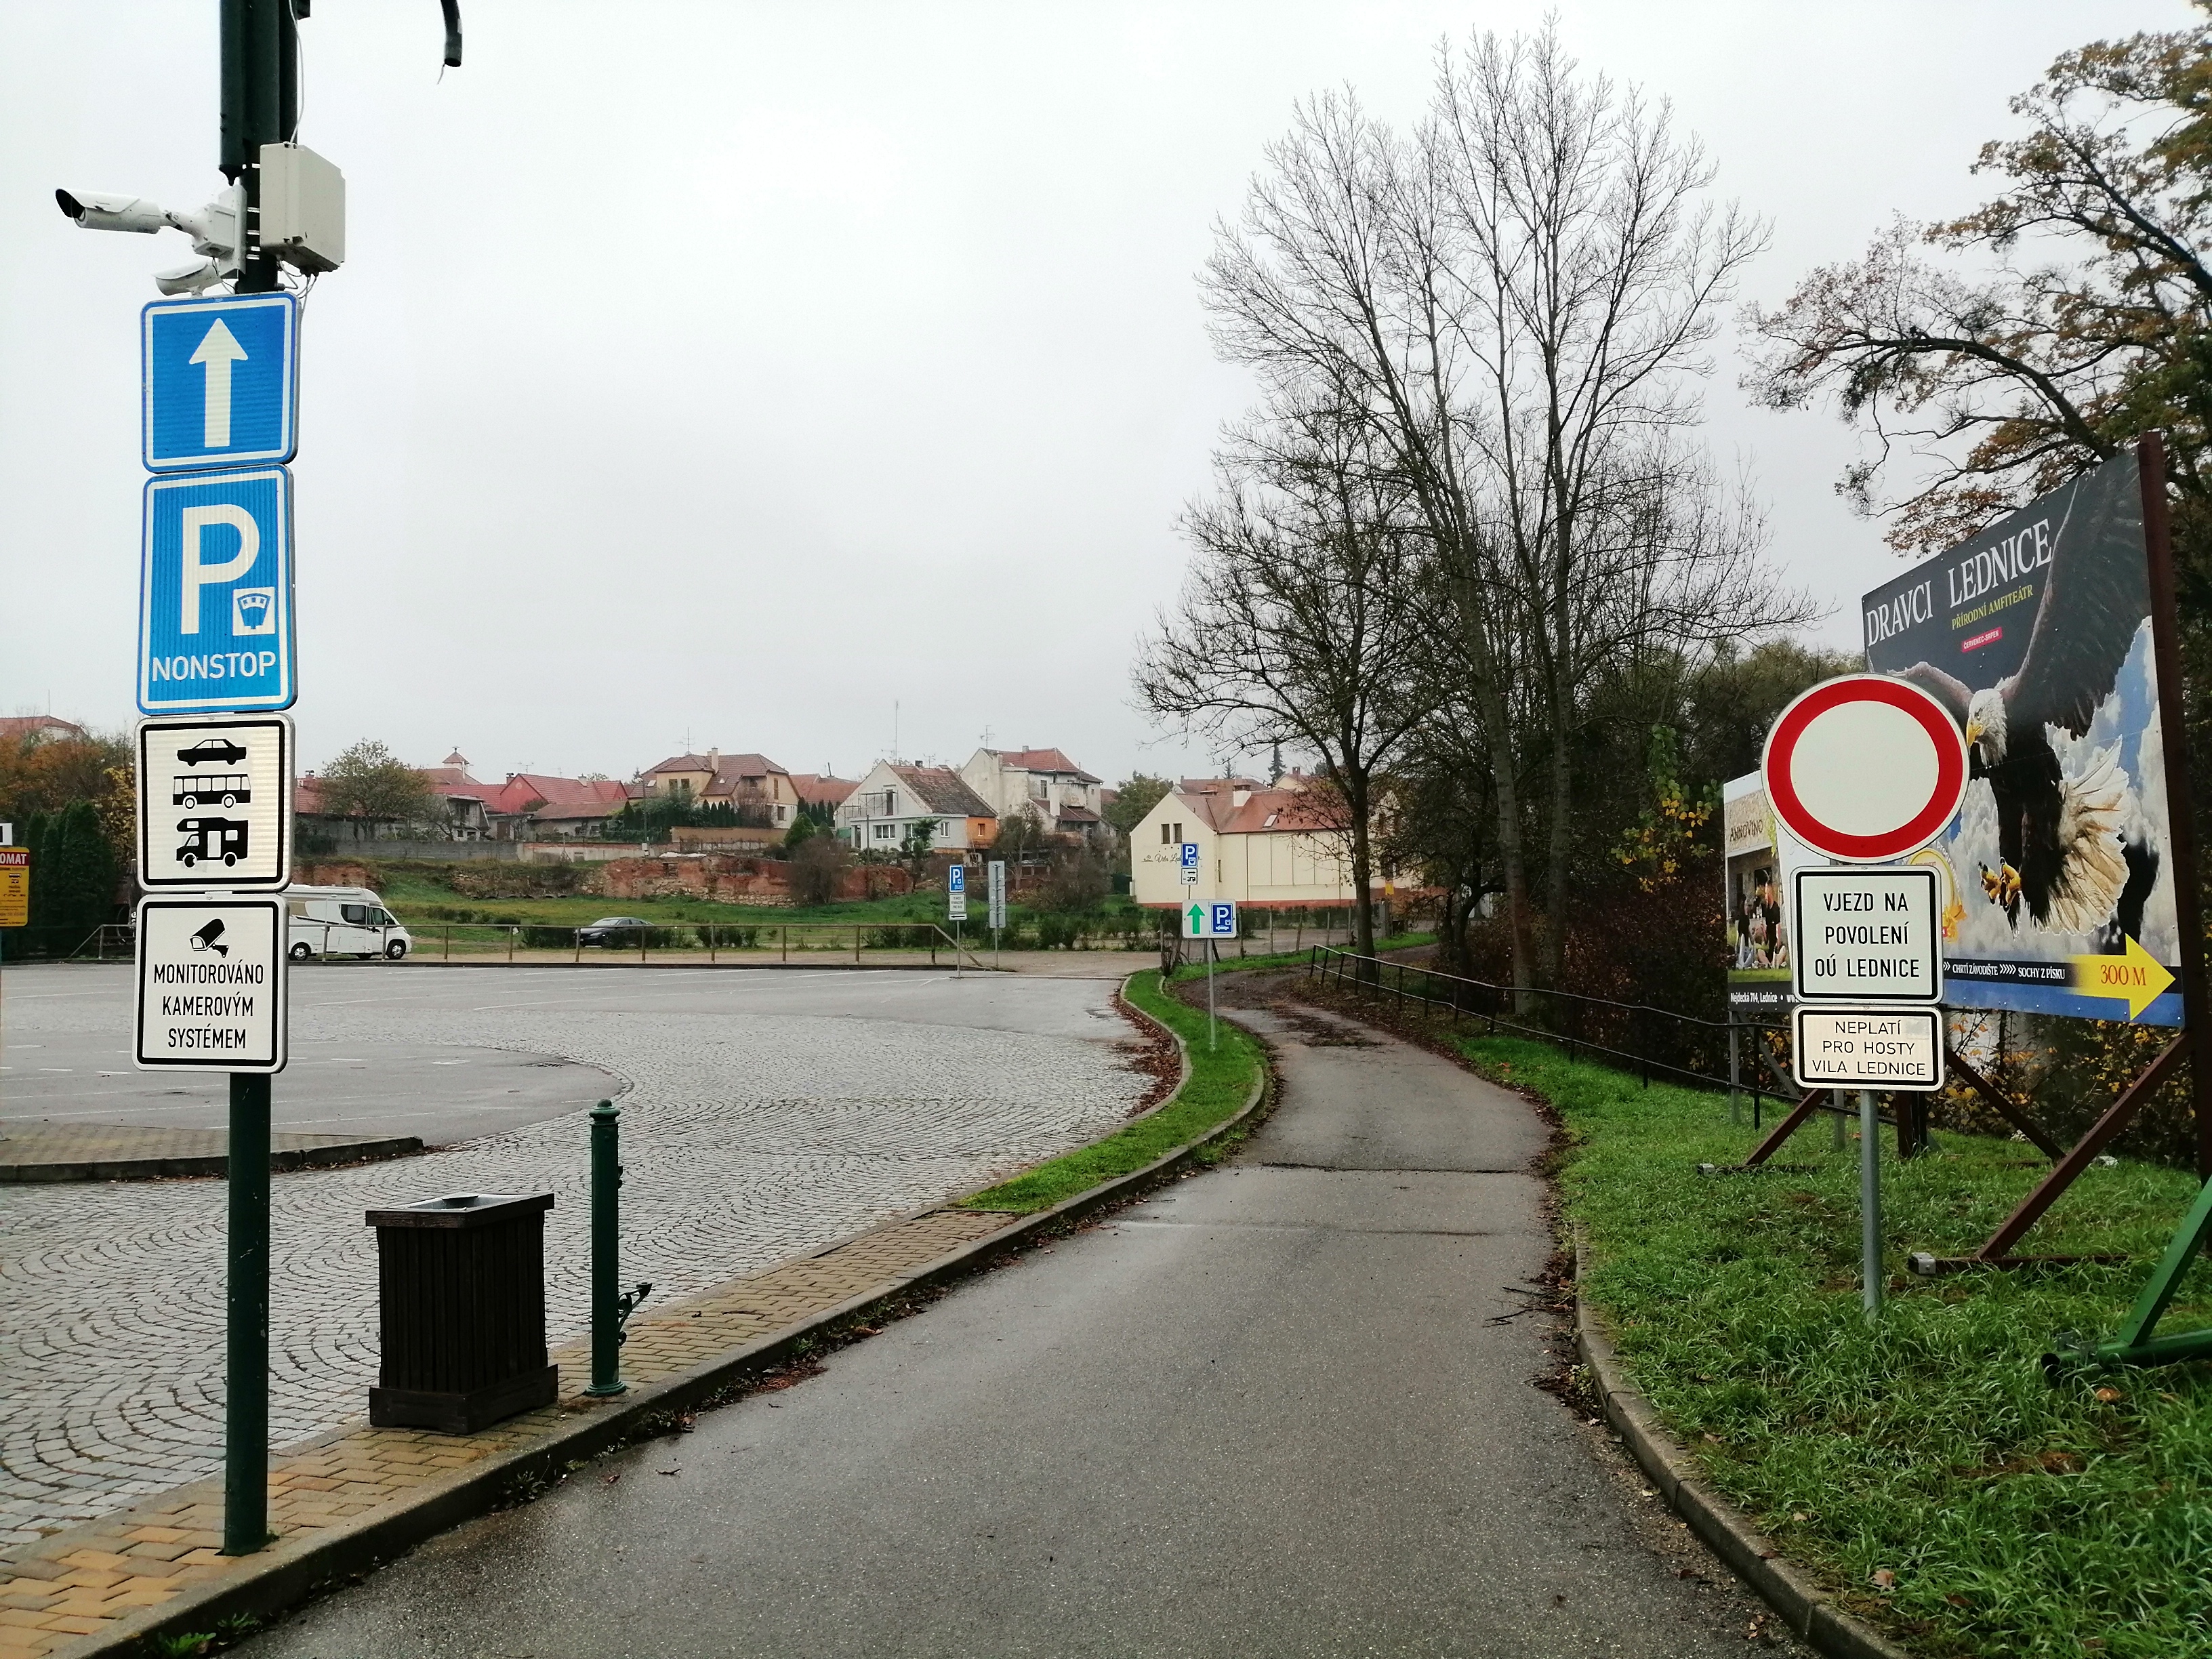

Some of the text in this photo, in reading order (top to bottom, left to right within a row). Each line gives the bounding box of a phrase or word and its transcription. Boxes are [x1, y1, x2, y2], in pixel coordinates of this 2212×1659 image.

[181, 504, 260, 635] P
[1866, 518, 2052, 647] DRAVCI LEDNICE
[1951, 584, 2034, 631] PŘÍRODNÍ AMFITEÁTR
[1963, 630, 1999, 649] ČERVENEC-SRPEN
[152, 651, 276, 682] NONSTOP
[1185, 845, 1195, 860] P
[952, 868, 961, 884] P
[1823, 893, 1908, 912] VJEZD NA
[1216, 907, 1229, 924] P
[1825, 921, 1910, 945] POVOLENÍ
[154, 959, 264, 985] MONITOROVÁNO
[1815, 954, 1920, 978] OÚ LEDNICE
[1952, 962, 1969, 974] CHRTÍ
[2018, 967, 2040, 979] SOCHY
[2041, 968, 2046, 979] Z
[2046, 966, 2066, 980] PÍSKU
[2100, 964, 2147, 986] 300 M
[163, 991, 253, 1017] KAMEROVÝM
[1730, 991, 1750, 1004] Nejdecká
[1750, 992, 1760, 1004] 714,
[1759, 991, 1778, 1003] Lednice
[168, 1023, 246, 1049] SYSTÉMEM
[1835, 1019, 1902, 1035] NEPLATÍ
[1823, 1040, 1915, 1055] PRO HOSTY
[1812, 1059, 1926, 1076] VILA LEDNICE
